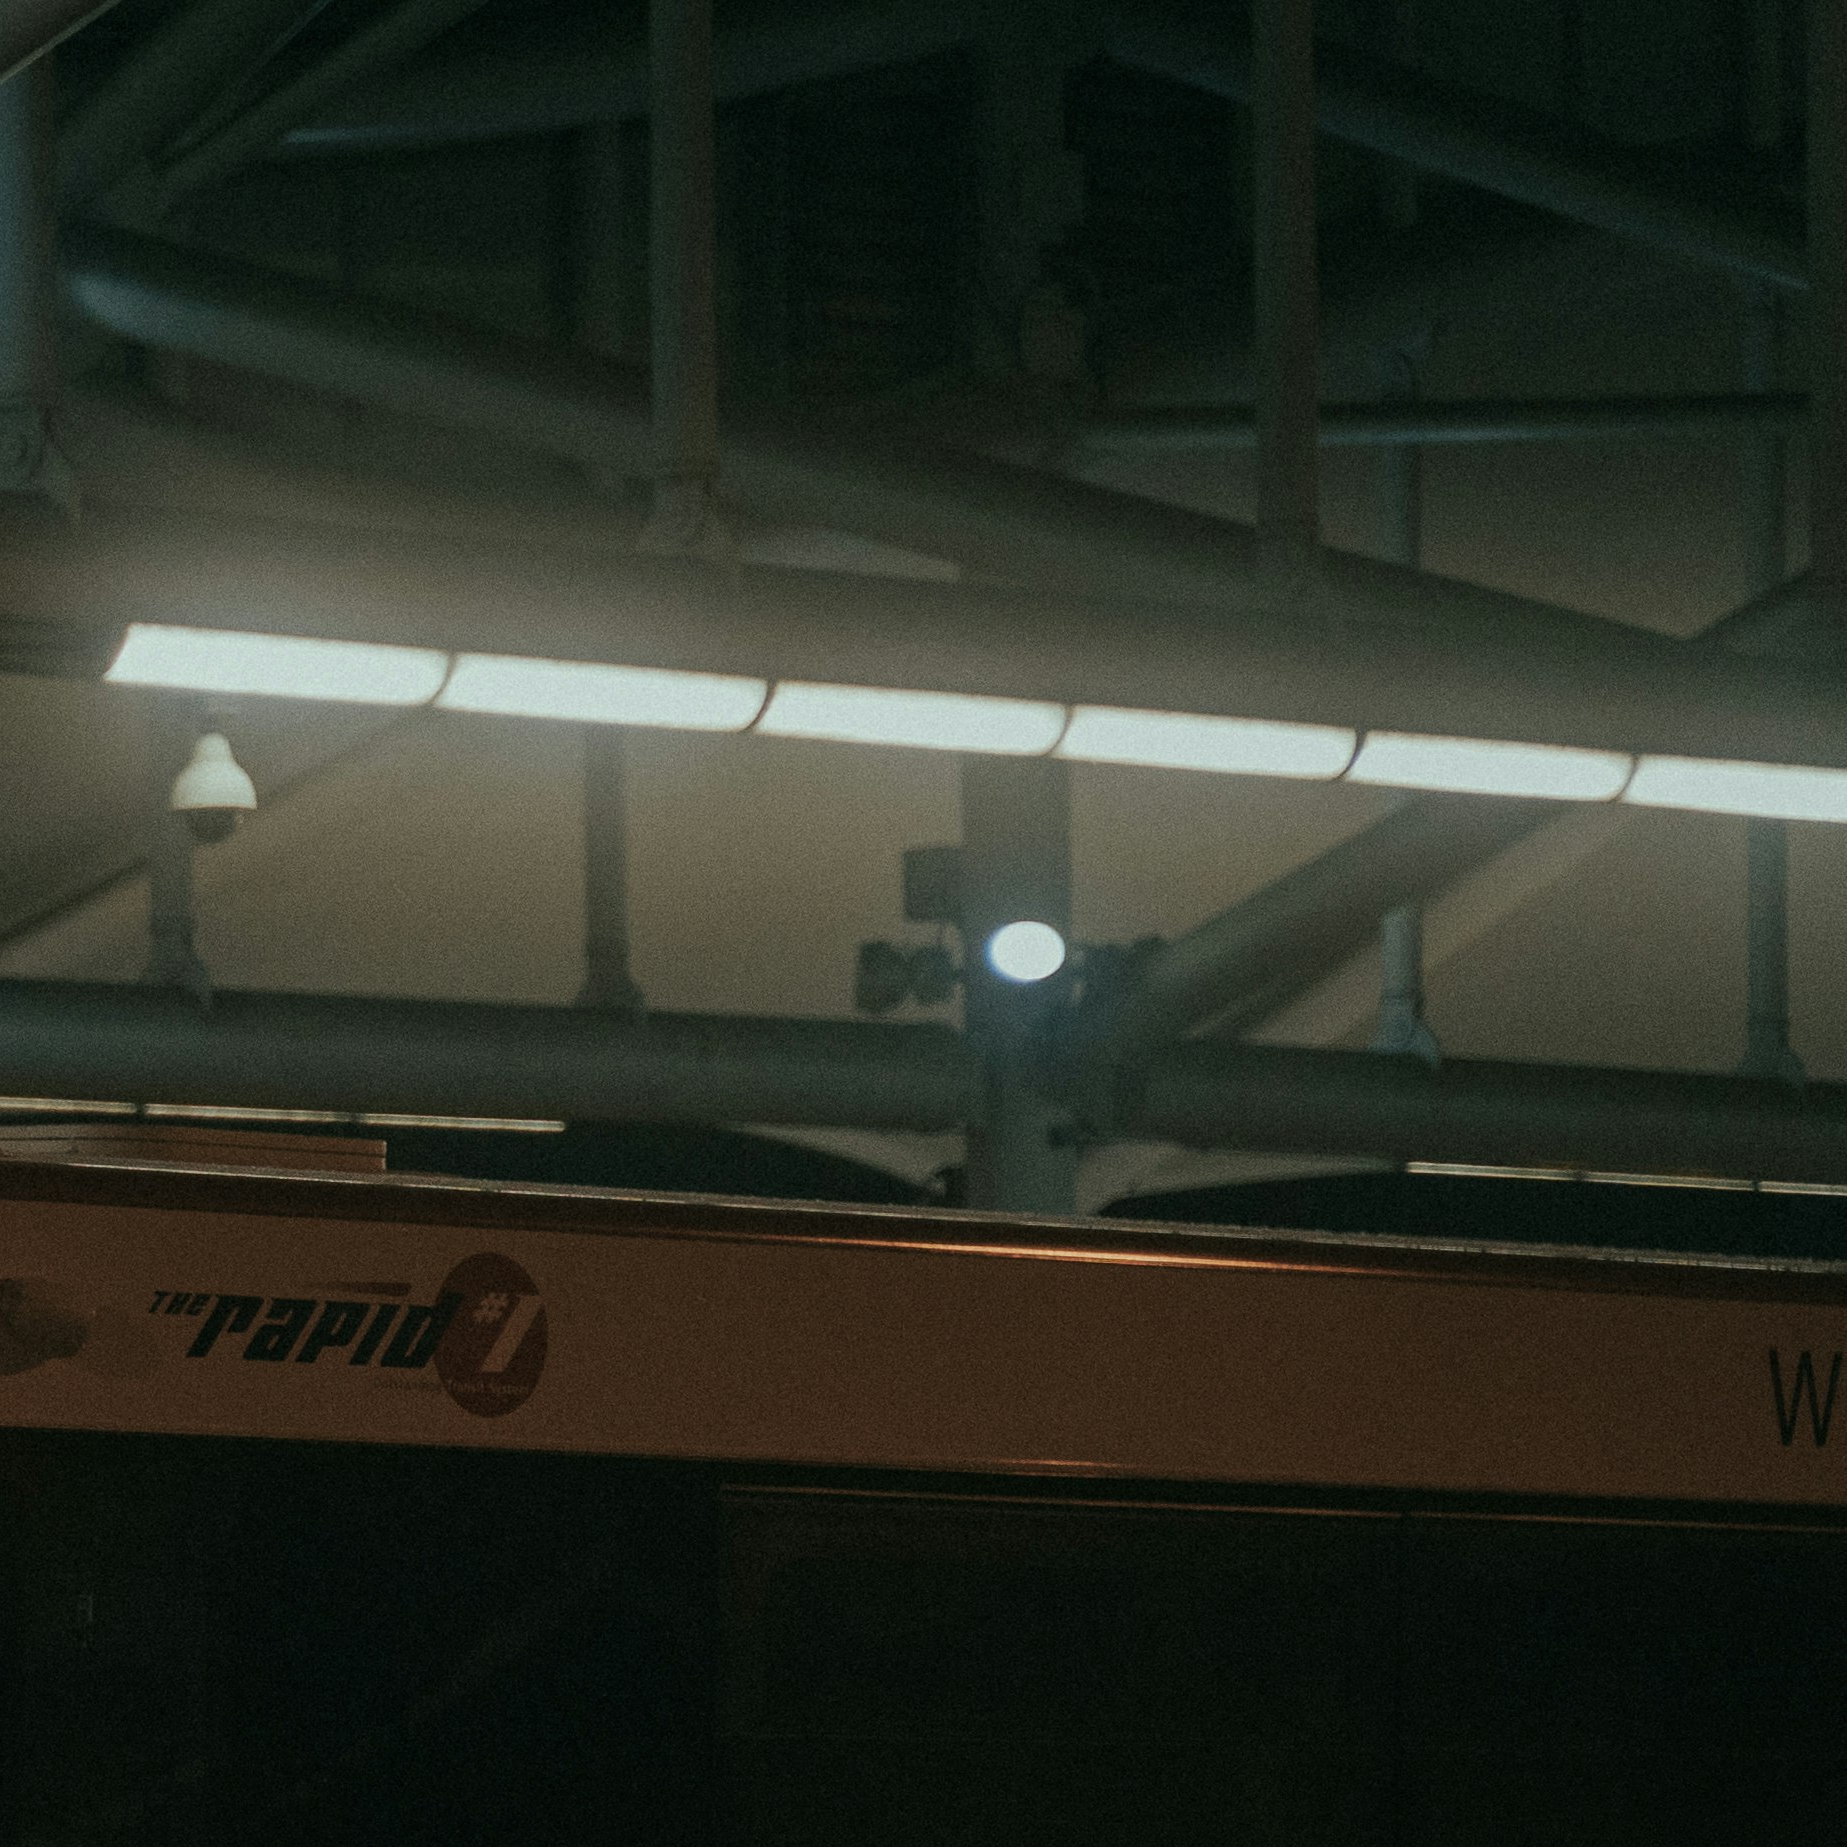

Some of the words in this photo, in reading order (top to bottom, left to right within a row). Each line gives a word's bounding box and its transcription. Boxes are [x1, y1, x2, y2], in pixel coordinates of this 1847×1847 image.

[148, 1289, 212, 1317] THE
[472, 1290, 542, 1373] #1
[1769, 1346, 1843, 1447] W
